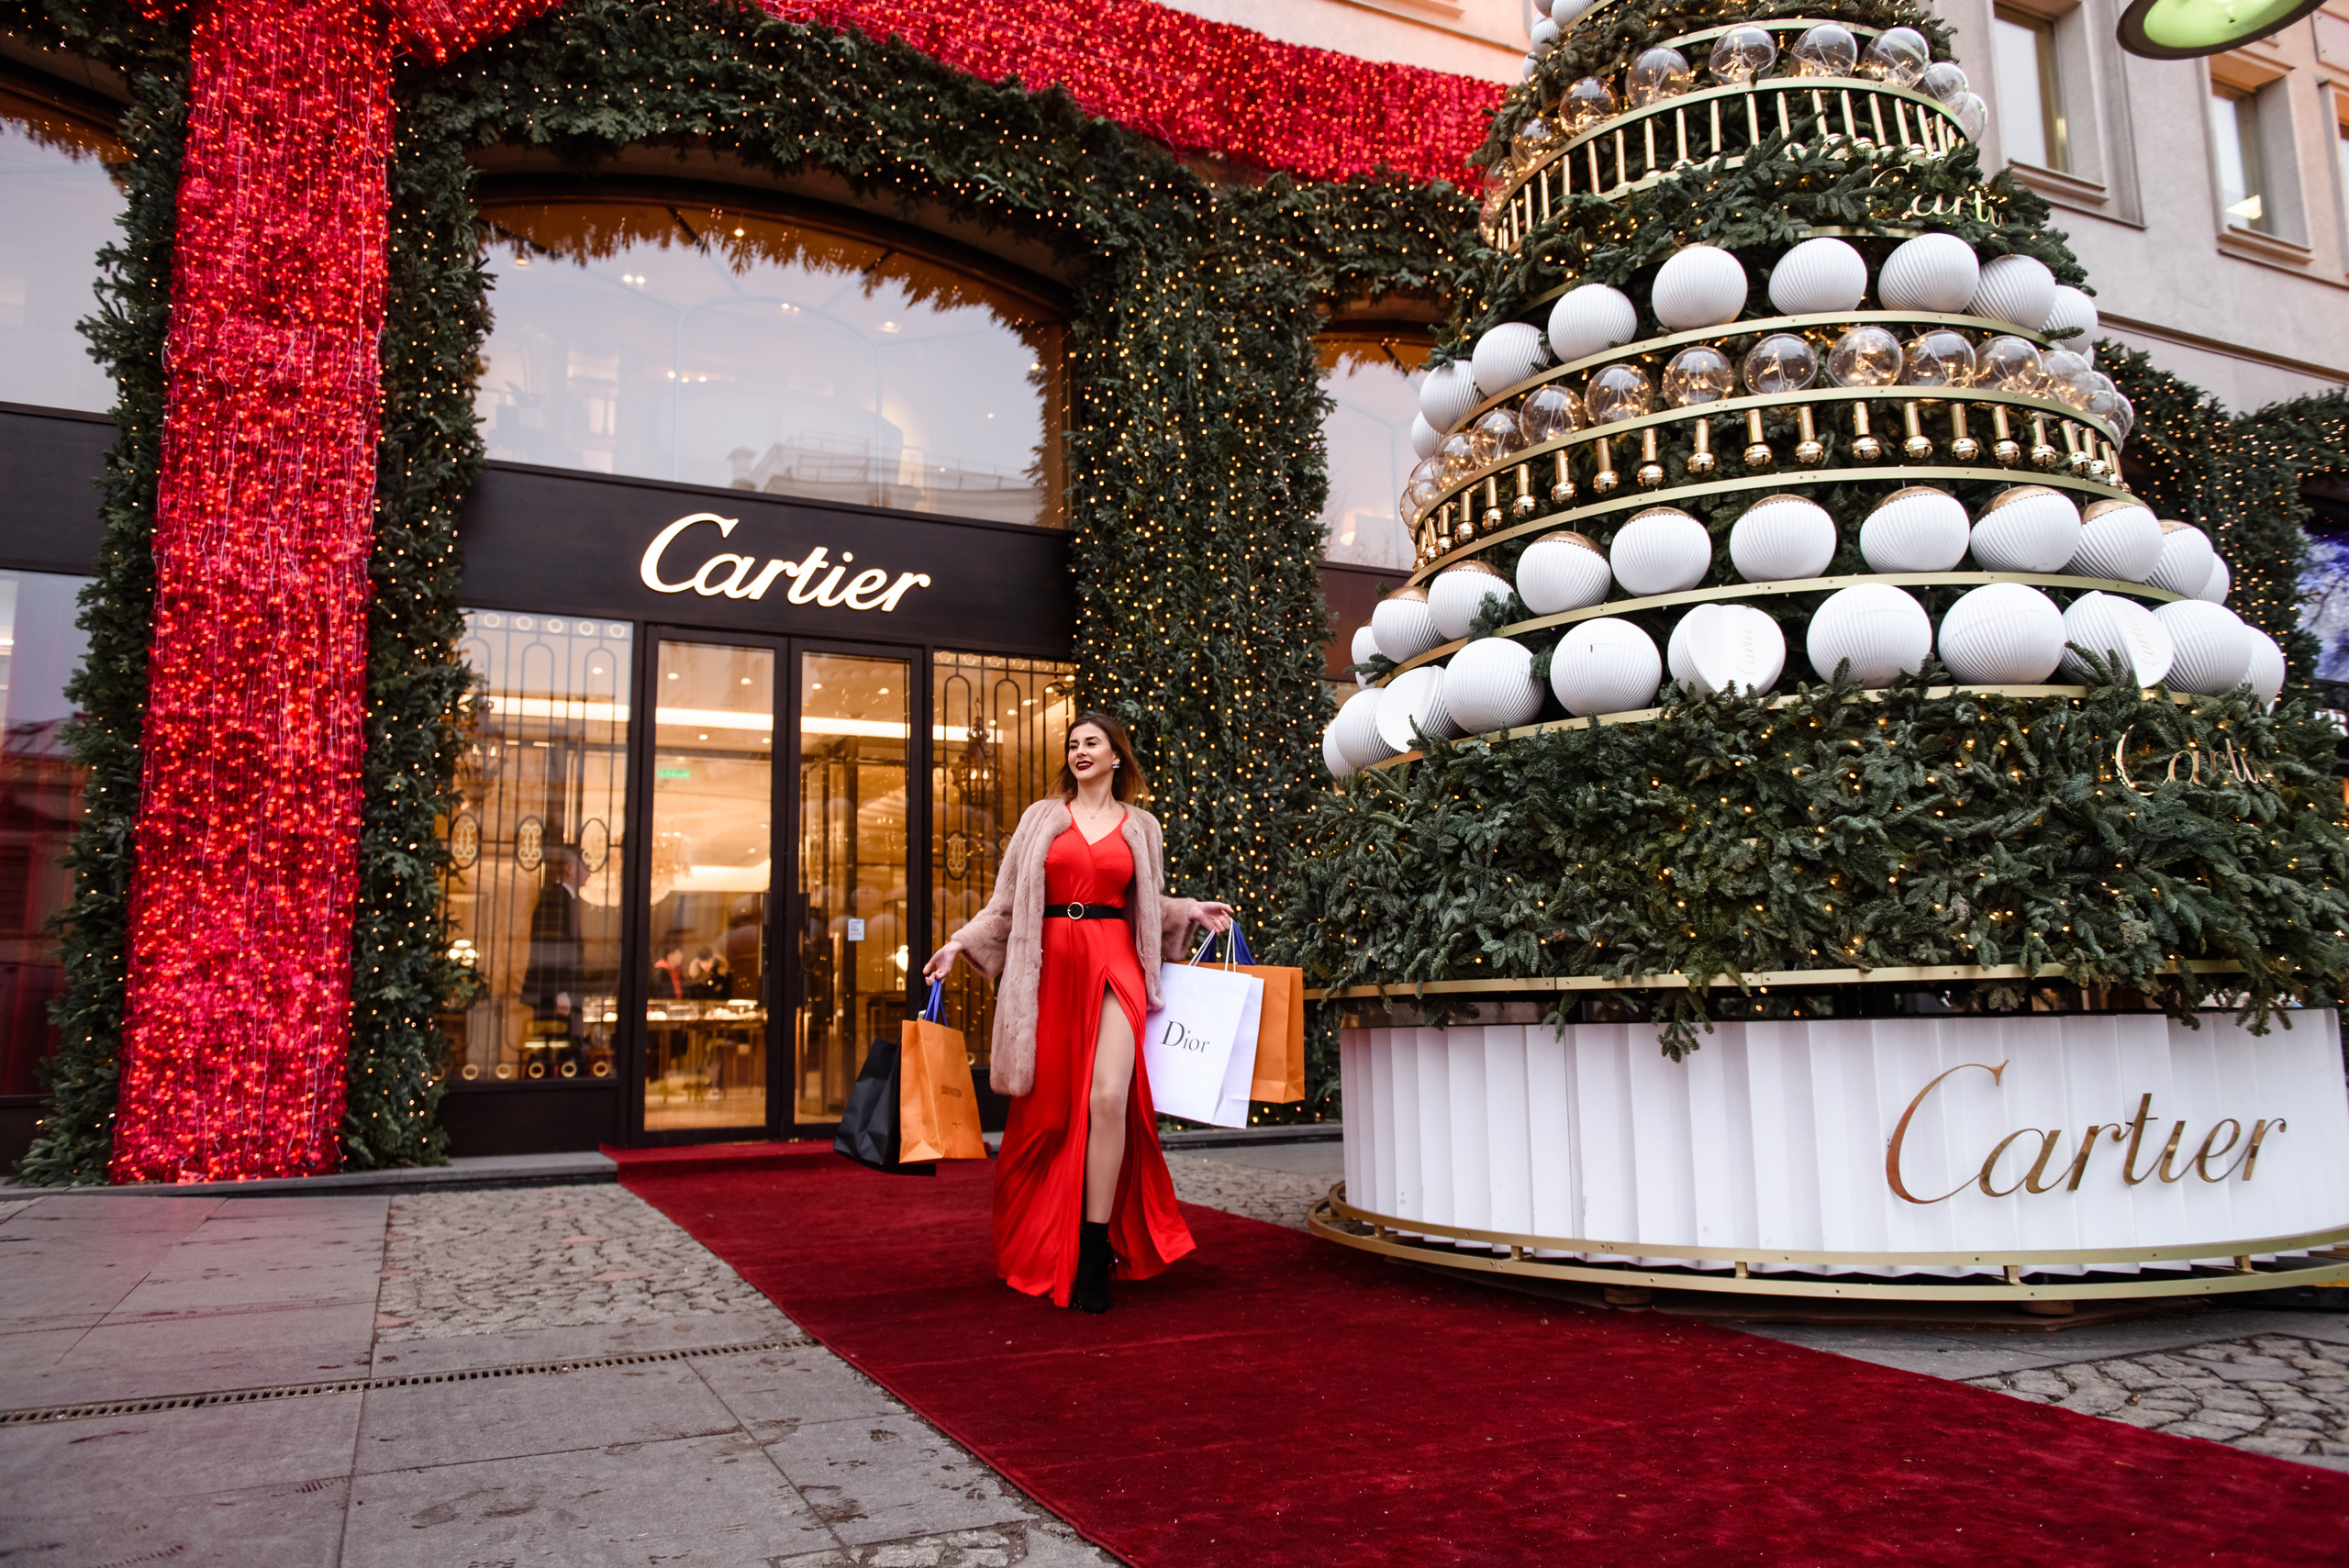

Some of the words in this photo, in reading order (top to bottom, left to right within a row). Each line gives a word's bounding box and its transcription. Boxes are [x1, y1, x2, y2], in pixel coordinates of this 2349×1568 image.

[640, 512, 931, 612] Cartier
[1158, 1019, 1210, 1053] Dior
[1886, 1059, 2288, 1206] Cartier
